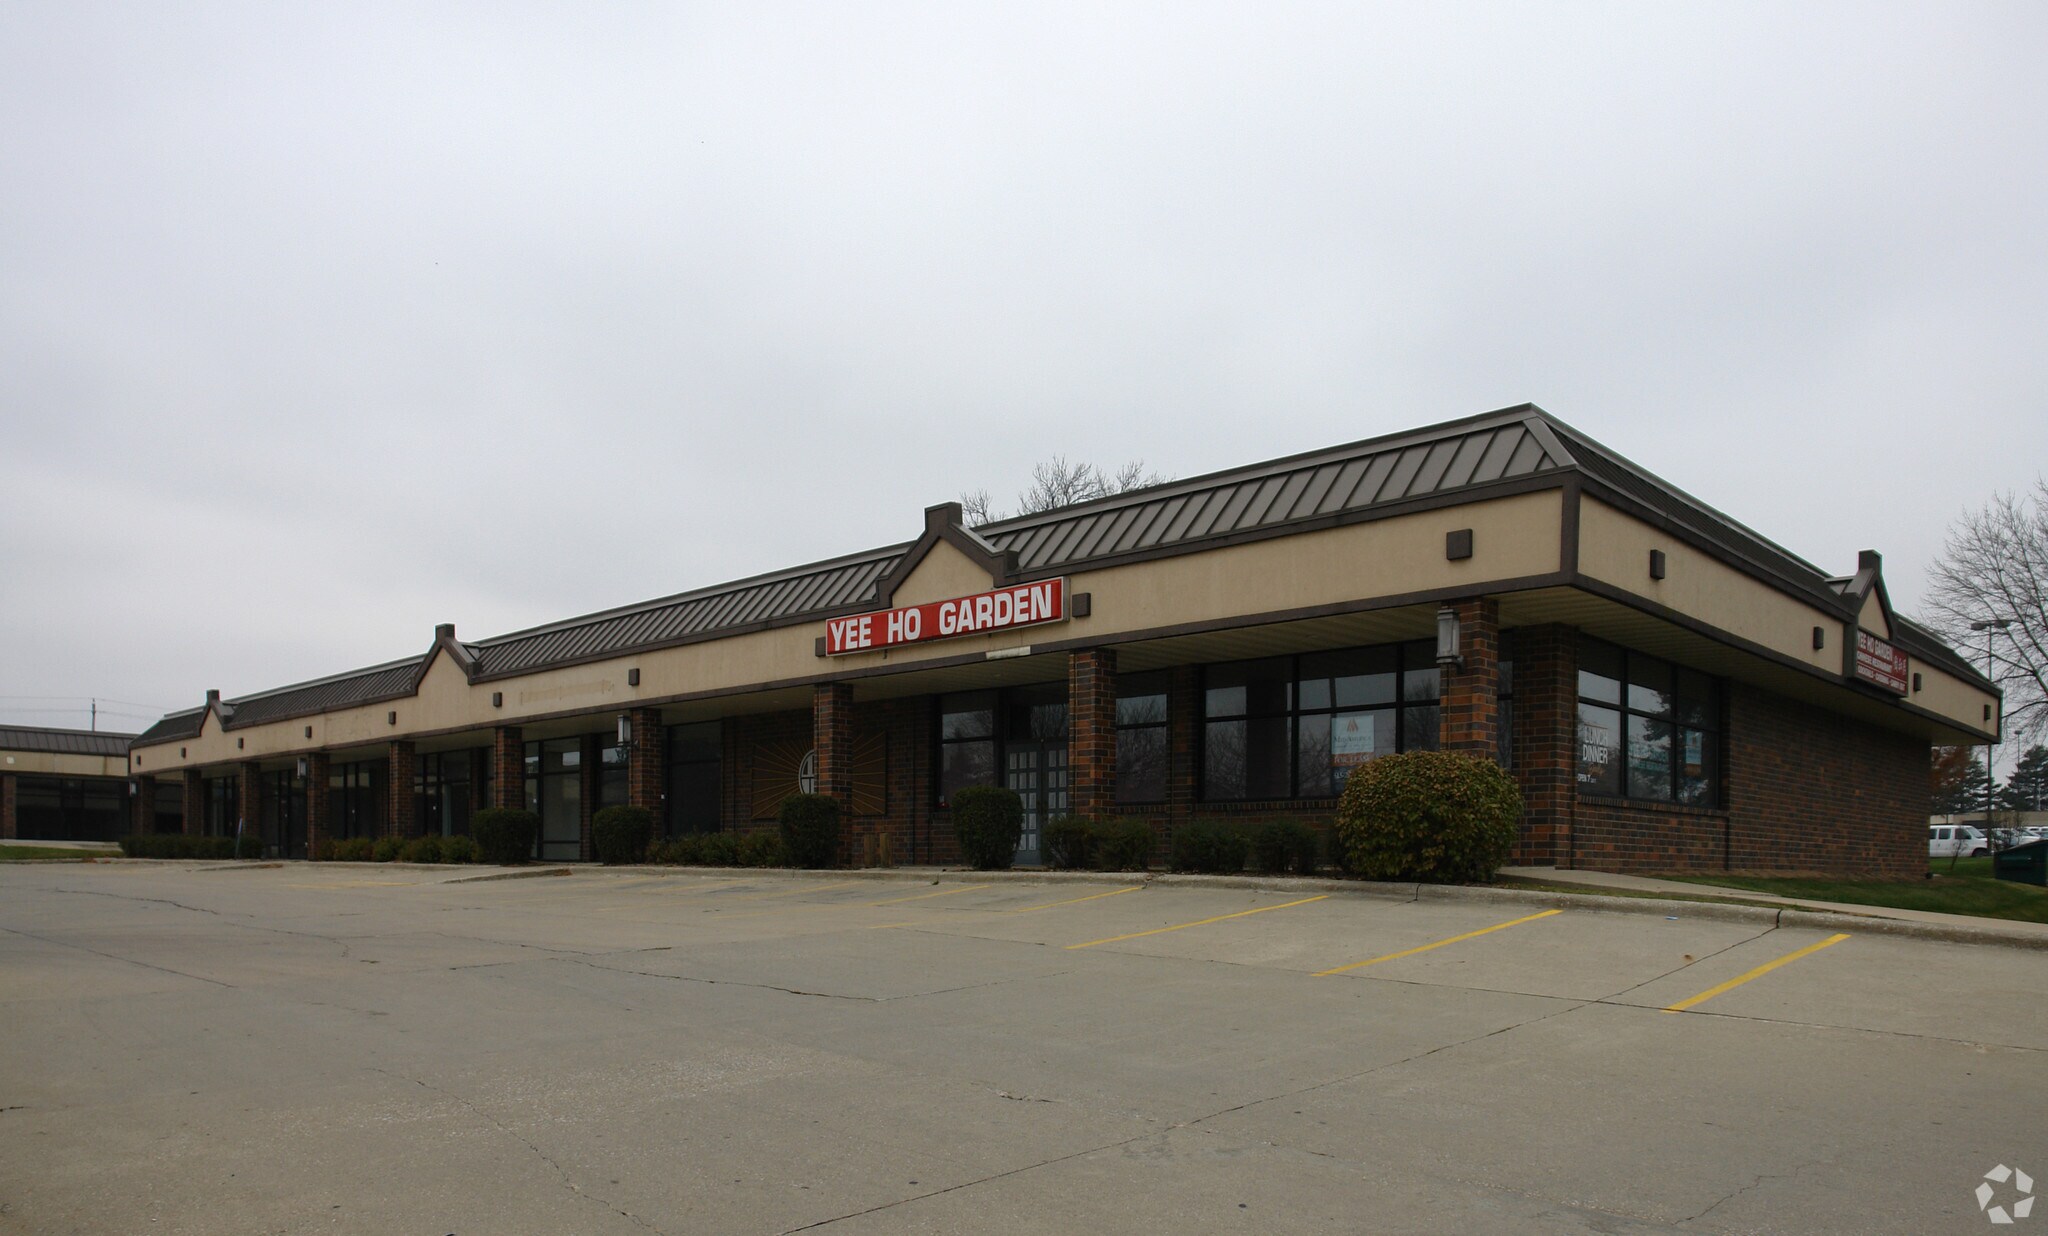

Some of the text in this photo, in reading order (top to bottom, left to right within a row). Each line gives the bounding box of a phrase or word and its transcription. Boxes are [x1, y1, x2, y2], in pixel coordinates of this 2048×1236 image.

[830, 583, 1052, 651] YEE HO GARDEN
[1584, 726, 1608, 747] LUNCH
[1583, 744, 1608, 764] DINNER
